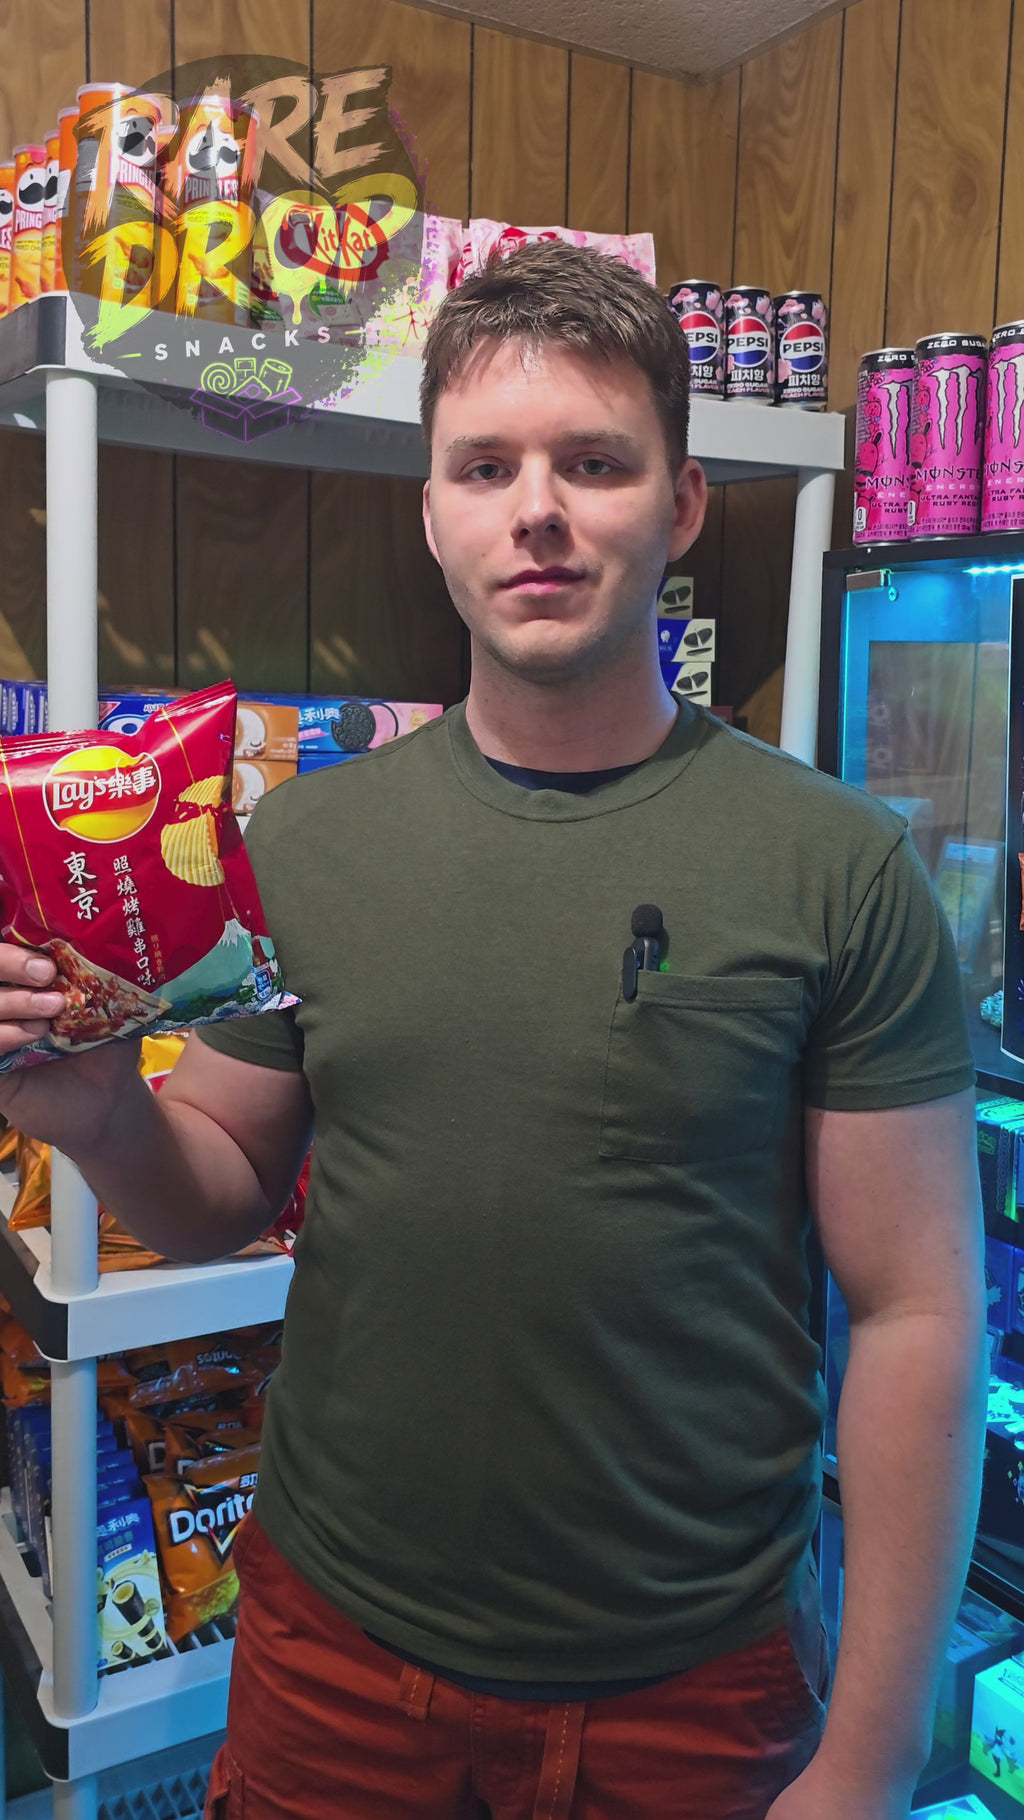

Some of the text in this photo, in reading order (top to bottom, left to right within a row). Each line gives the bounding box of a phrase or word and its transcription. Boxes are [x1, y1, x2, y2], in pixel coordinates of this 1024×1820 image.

[15, 209, 42, 233] PRING
[304, 212, 374, 267] KitKat
[686, 332, 718, 344] EPSI
[728, 336, 768, 348] PEPSI
[927, 338, 985, 349] ZERO SUGA
[783, 342, 823, 354] PEPSI
[877, 352, 907, 362] ZERO
[691, 365, 714, 378] 치향
[915, 466, 980, 481] MONSTE
[988, 477, 1024, 486] ENER
[877, 491, 906, 499] ENE
[53, 762, 156, 811] Lay's 樂事
[63, 851, 100, 920] 東京
[112, 855, 155, 987] 照燒烤雞串口味
[170, 1493, 254, 1543] Dorit
